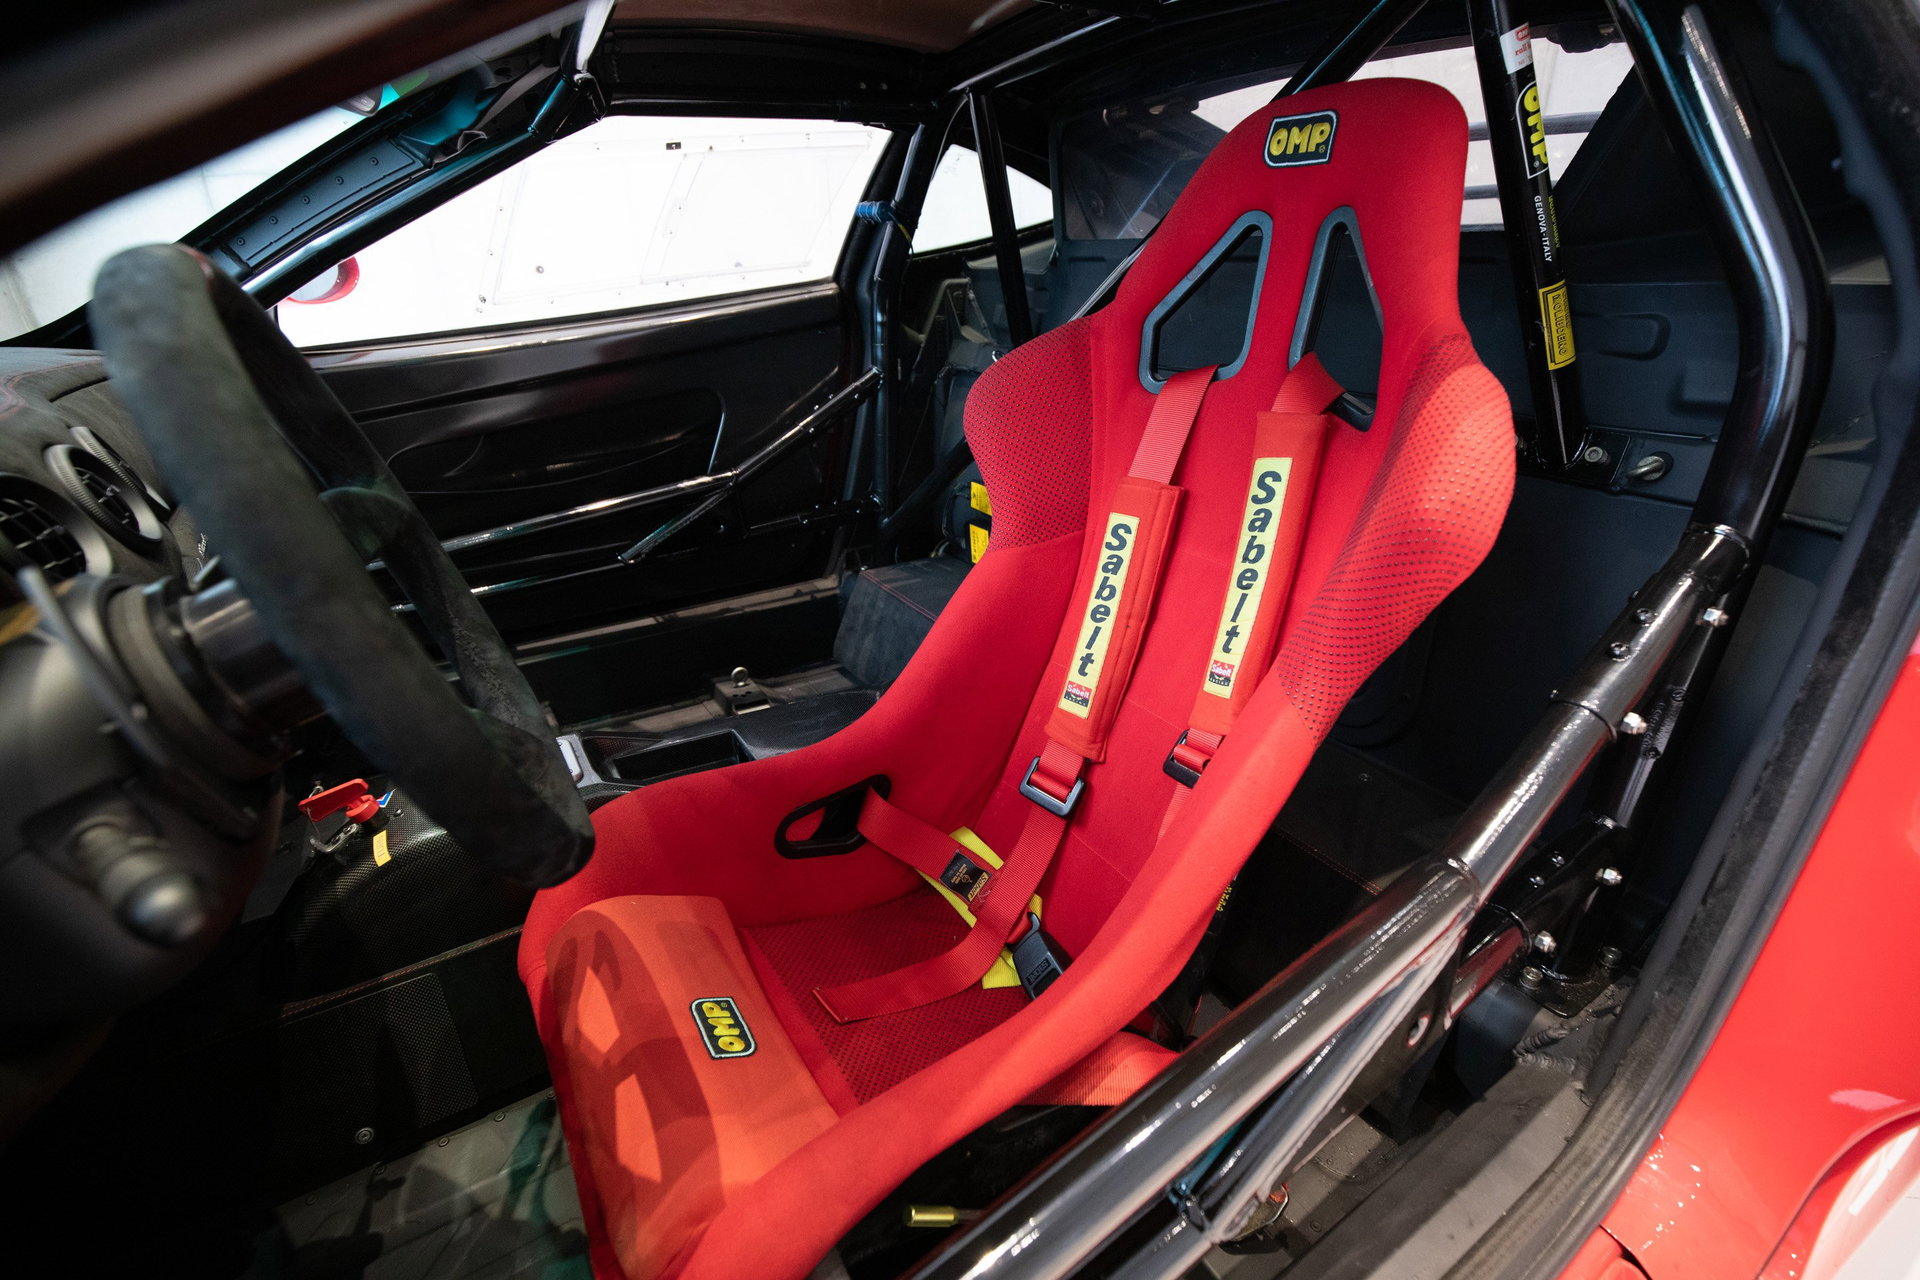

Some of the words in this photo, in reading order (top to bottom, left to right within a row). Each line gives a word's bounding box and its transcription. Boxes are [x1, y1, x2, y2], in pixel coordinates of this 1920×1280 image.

[1269, 122, 1331, 156] OMP
[1534, 195, 1552, 262] GENOVA-ITALY
[1552, 294, 1568, 355] MOLIBDENO
[1222, 470, 1282, 654] Sabelt
[1077, 523, 1132, 677] Sabelt
[1067, 684, 1090, 699] Sabelt
[1211, 663, 1232, 677] Sabelt
[702, 1002, 746, 1052] OMP
